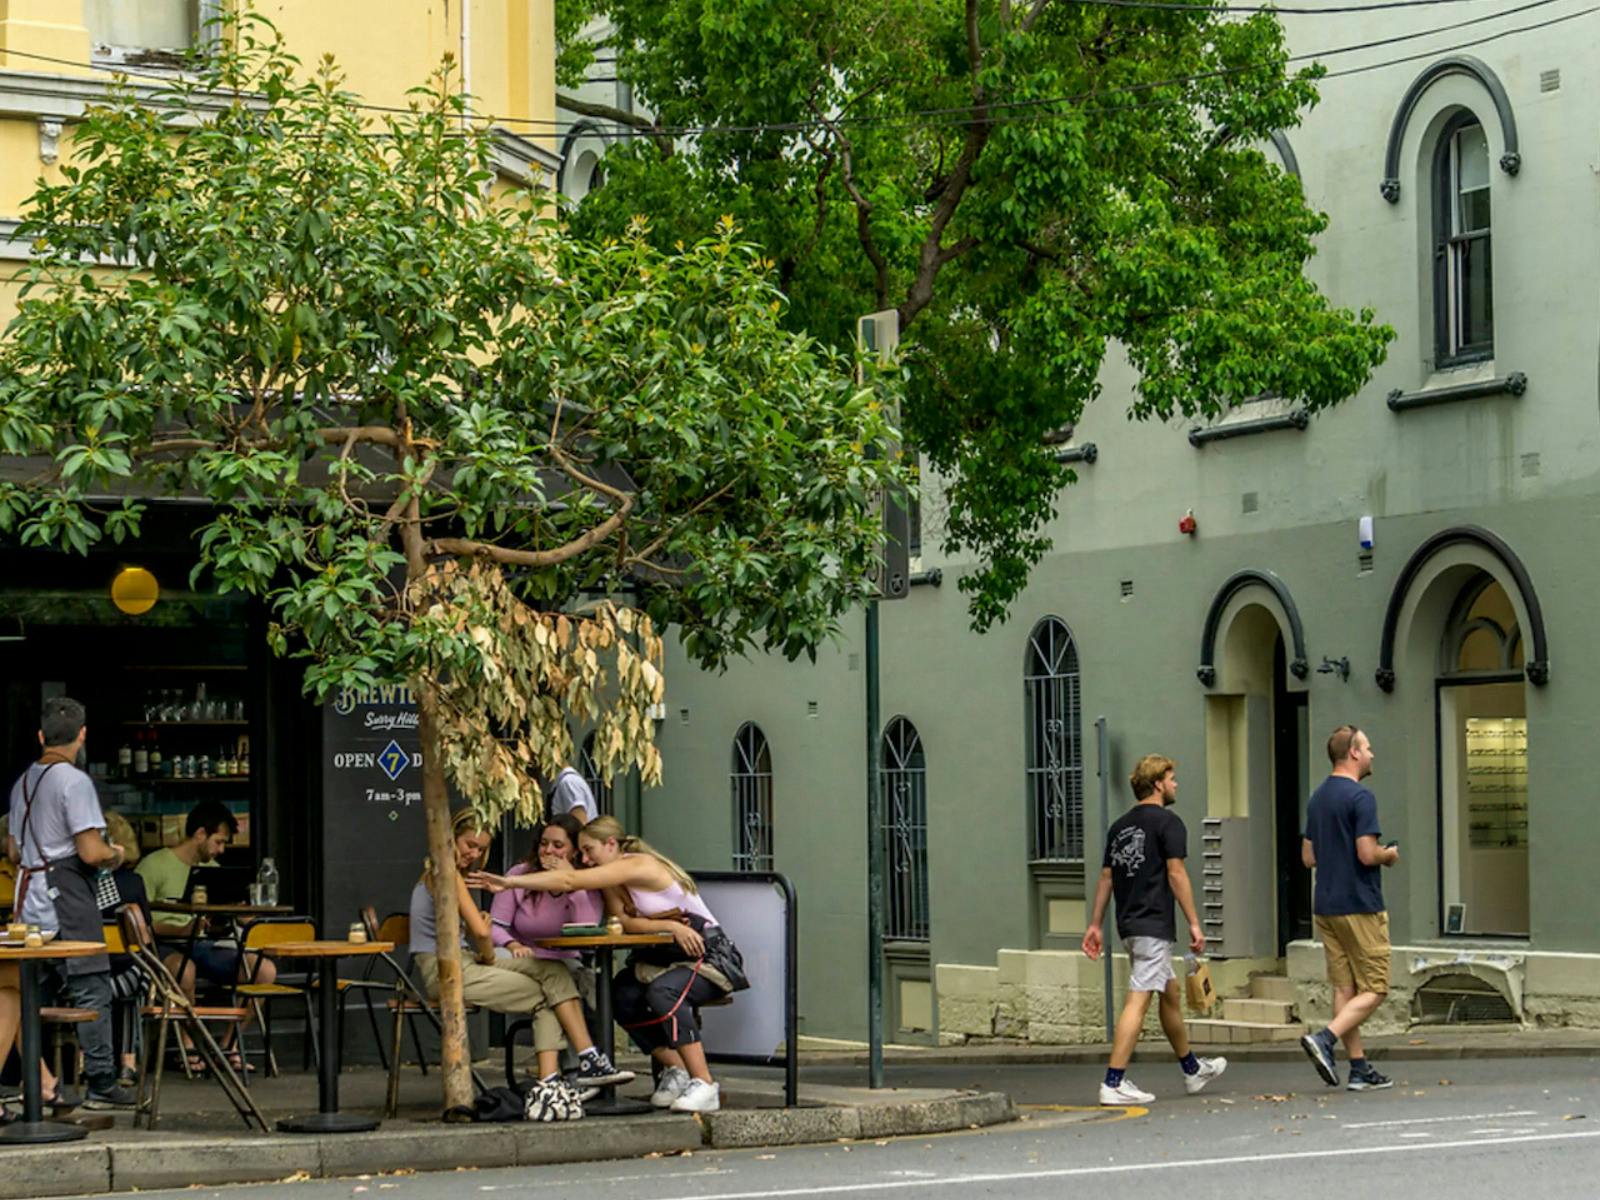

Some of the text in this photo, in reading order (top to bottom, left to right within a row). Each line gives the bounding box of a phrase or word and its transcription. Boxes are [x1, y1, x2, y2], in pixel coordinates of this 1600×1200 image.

[334, 753, 375, 768] OPEN
[386, 753, 400, 773] 7
[365, 788, 422, 806] 7am-3pm
